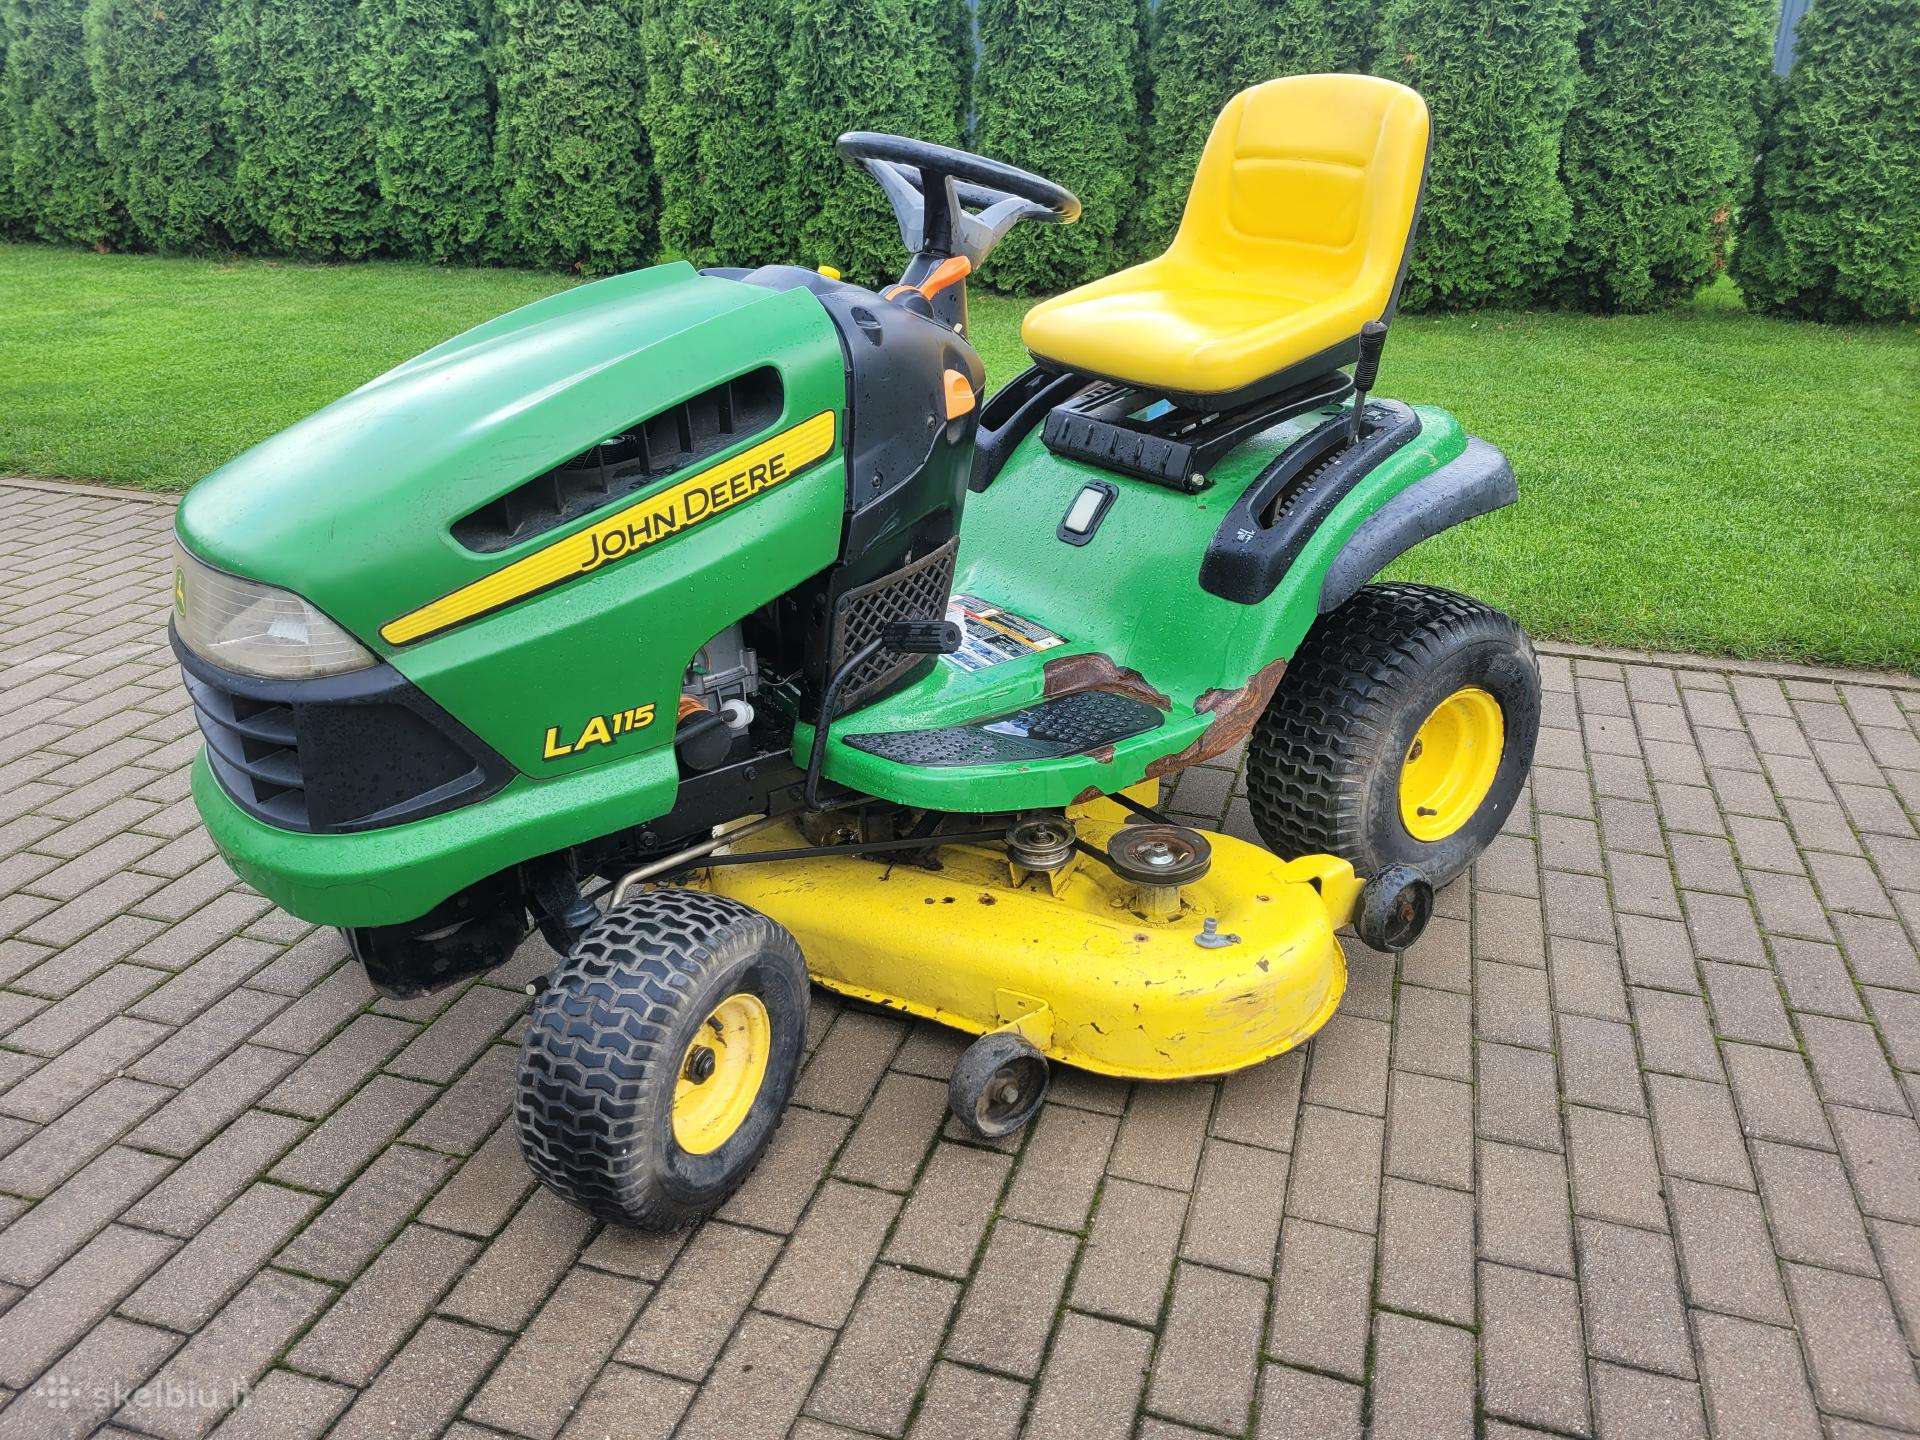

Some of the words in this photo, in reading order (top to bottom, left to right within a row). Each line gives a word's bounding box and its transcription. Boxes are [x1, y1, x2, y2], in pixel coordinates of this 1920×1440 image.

[581, 505, 677, 568] JOHN
[683, 452, 786, 522] DEERE
[543, 703, 656, 759] LA115
